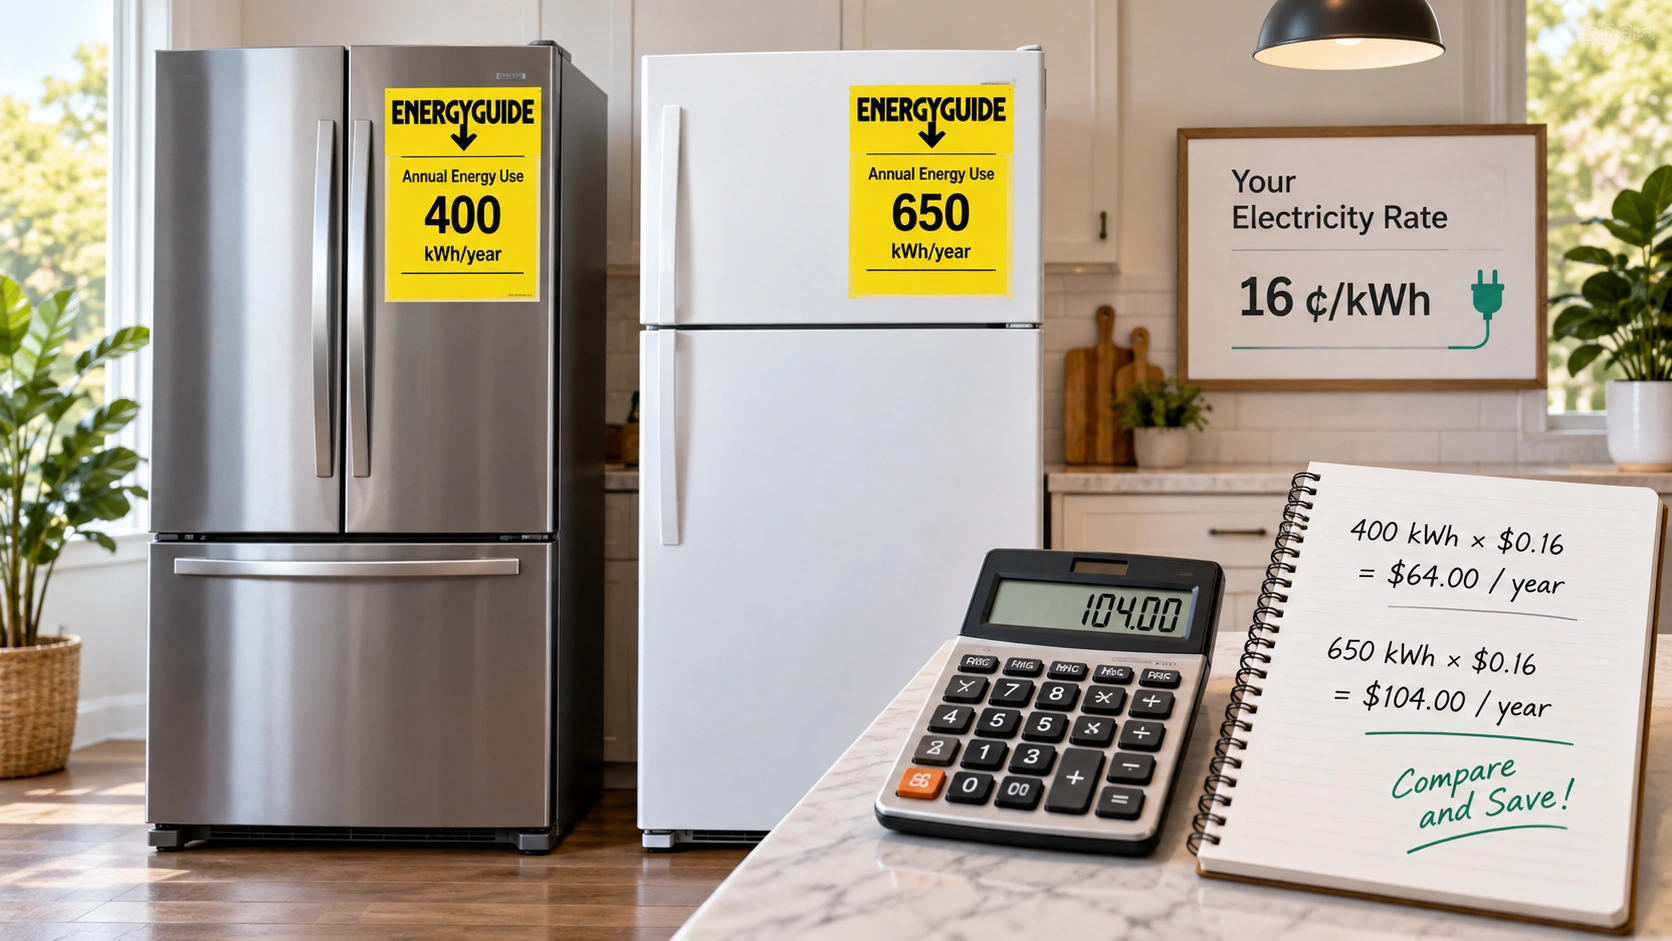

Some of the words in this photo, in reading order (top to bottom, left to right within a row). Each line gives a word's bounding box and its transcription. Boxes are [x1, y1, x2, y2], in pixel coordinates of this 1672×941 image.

[392, 99, 534, 126] ENERGYGUIDE
[858, 97, 1006, 124] ENERGYGUIDE
[402, 169, 447, 184] Annual
[451, 169, 496, 187] Energy
[500, 169, 524, 184] Use
[868, 166, 915, 181] Annual
[919, 166, 965, 184] Energy
[969, 166, 994, 181] Use
[1231, 169, 1297, 194] Your
[425, 195, 500, 234] 400
[892, 193, 970, 232] 650
[1232, 204, 1374, 236] Electricity
[1384, 205, 1448, 230] Rate
[424, 245, 502, 265] kWh/year
[891, 243, 971, 263] kWh/year
[1240, 276, 1294, 317] 16
[1306, 282, 1431, 323] ¢/kWh
[1350, 518, 1398, 543] 400
[1407, 521, 1459, 547] kWh
[1497, 527, 1564, 556] $0.16
[1387, 559, 1479, 589] $64.00
[1511, 577, 1565, 602] year
[1082, 593, 1182, 633] 104.00
[1327, 636, 1375, 662] 650
[1384, 641, 1435, 667] kWh
[1472, 647, 1537, 676] $0.16
[1363, 680, 1465, 713] $104.00
[1497, 700, 1552, 726] year
[1391, 758, 1517, 799] Compare
[1419, 791, 1474, 829] and
[1485, 777, 1575, 818] Save!
